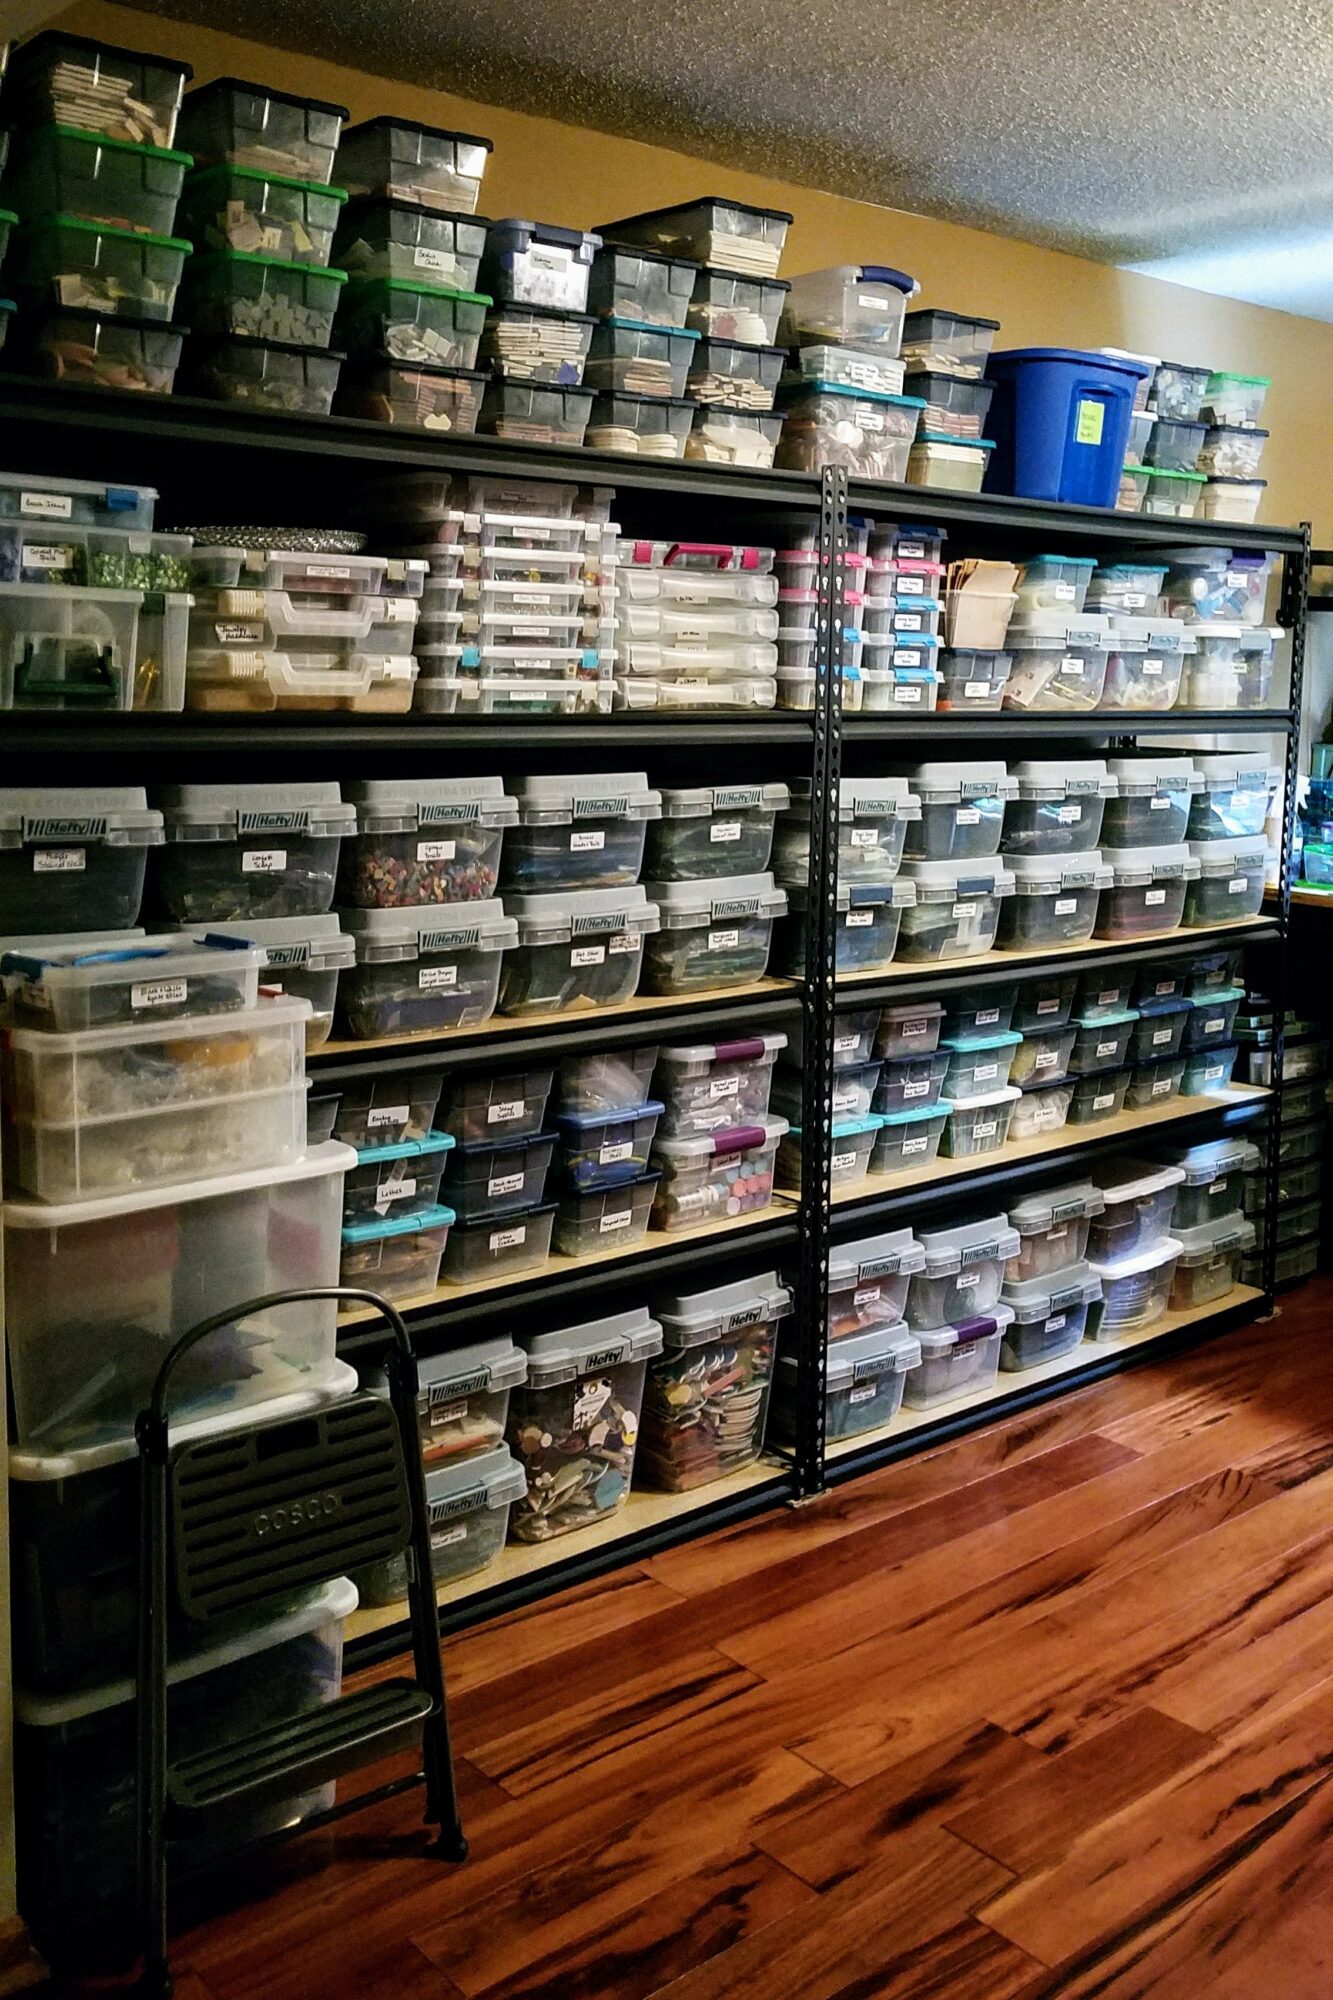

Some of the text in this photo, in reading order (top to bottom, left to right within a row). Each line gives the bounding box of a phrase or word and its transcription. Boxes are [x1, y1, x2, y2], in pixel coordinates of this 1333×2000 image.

[728, 792, 749, 804] Hefty
[436, 806, 465, 819] Hefty
[589, 800, 616, 813] Hefty
[259, 812, 292, 828] Hefty
[50, 820, 87, 836] Hefty
[726, 902, 748, 914] Hefty
[589, 916, 614, 930] Hefty
[436, 931, 465, 946] Hefty
[732, 1309, 759, 1327] Hefty
[588, 1350, 620, 1368] Hefty
[448, 1380, 474, 1394] Hefty
[448, 1499, 473, 1511] Hefty
[254, 1494, 340, 1536] COSCO
